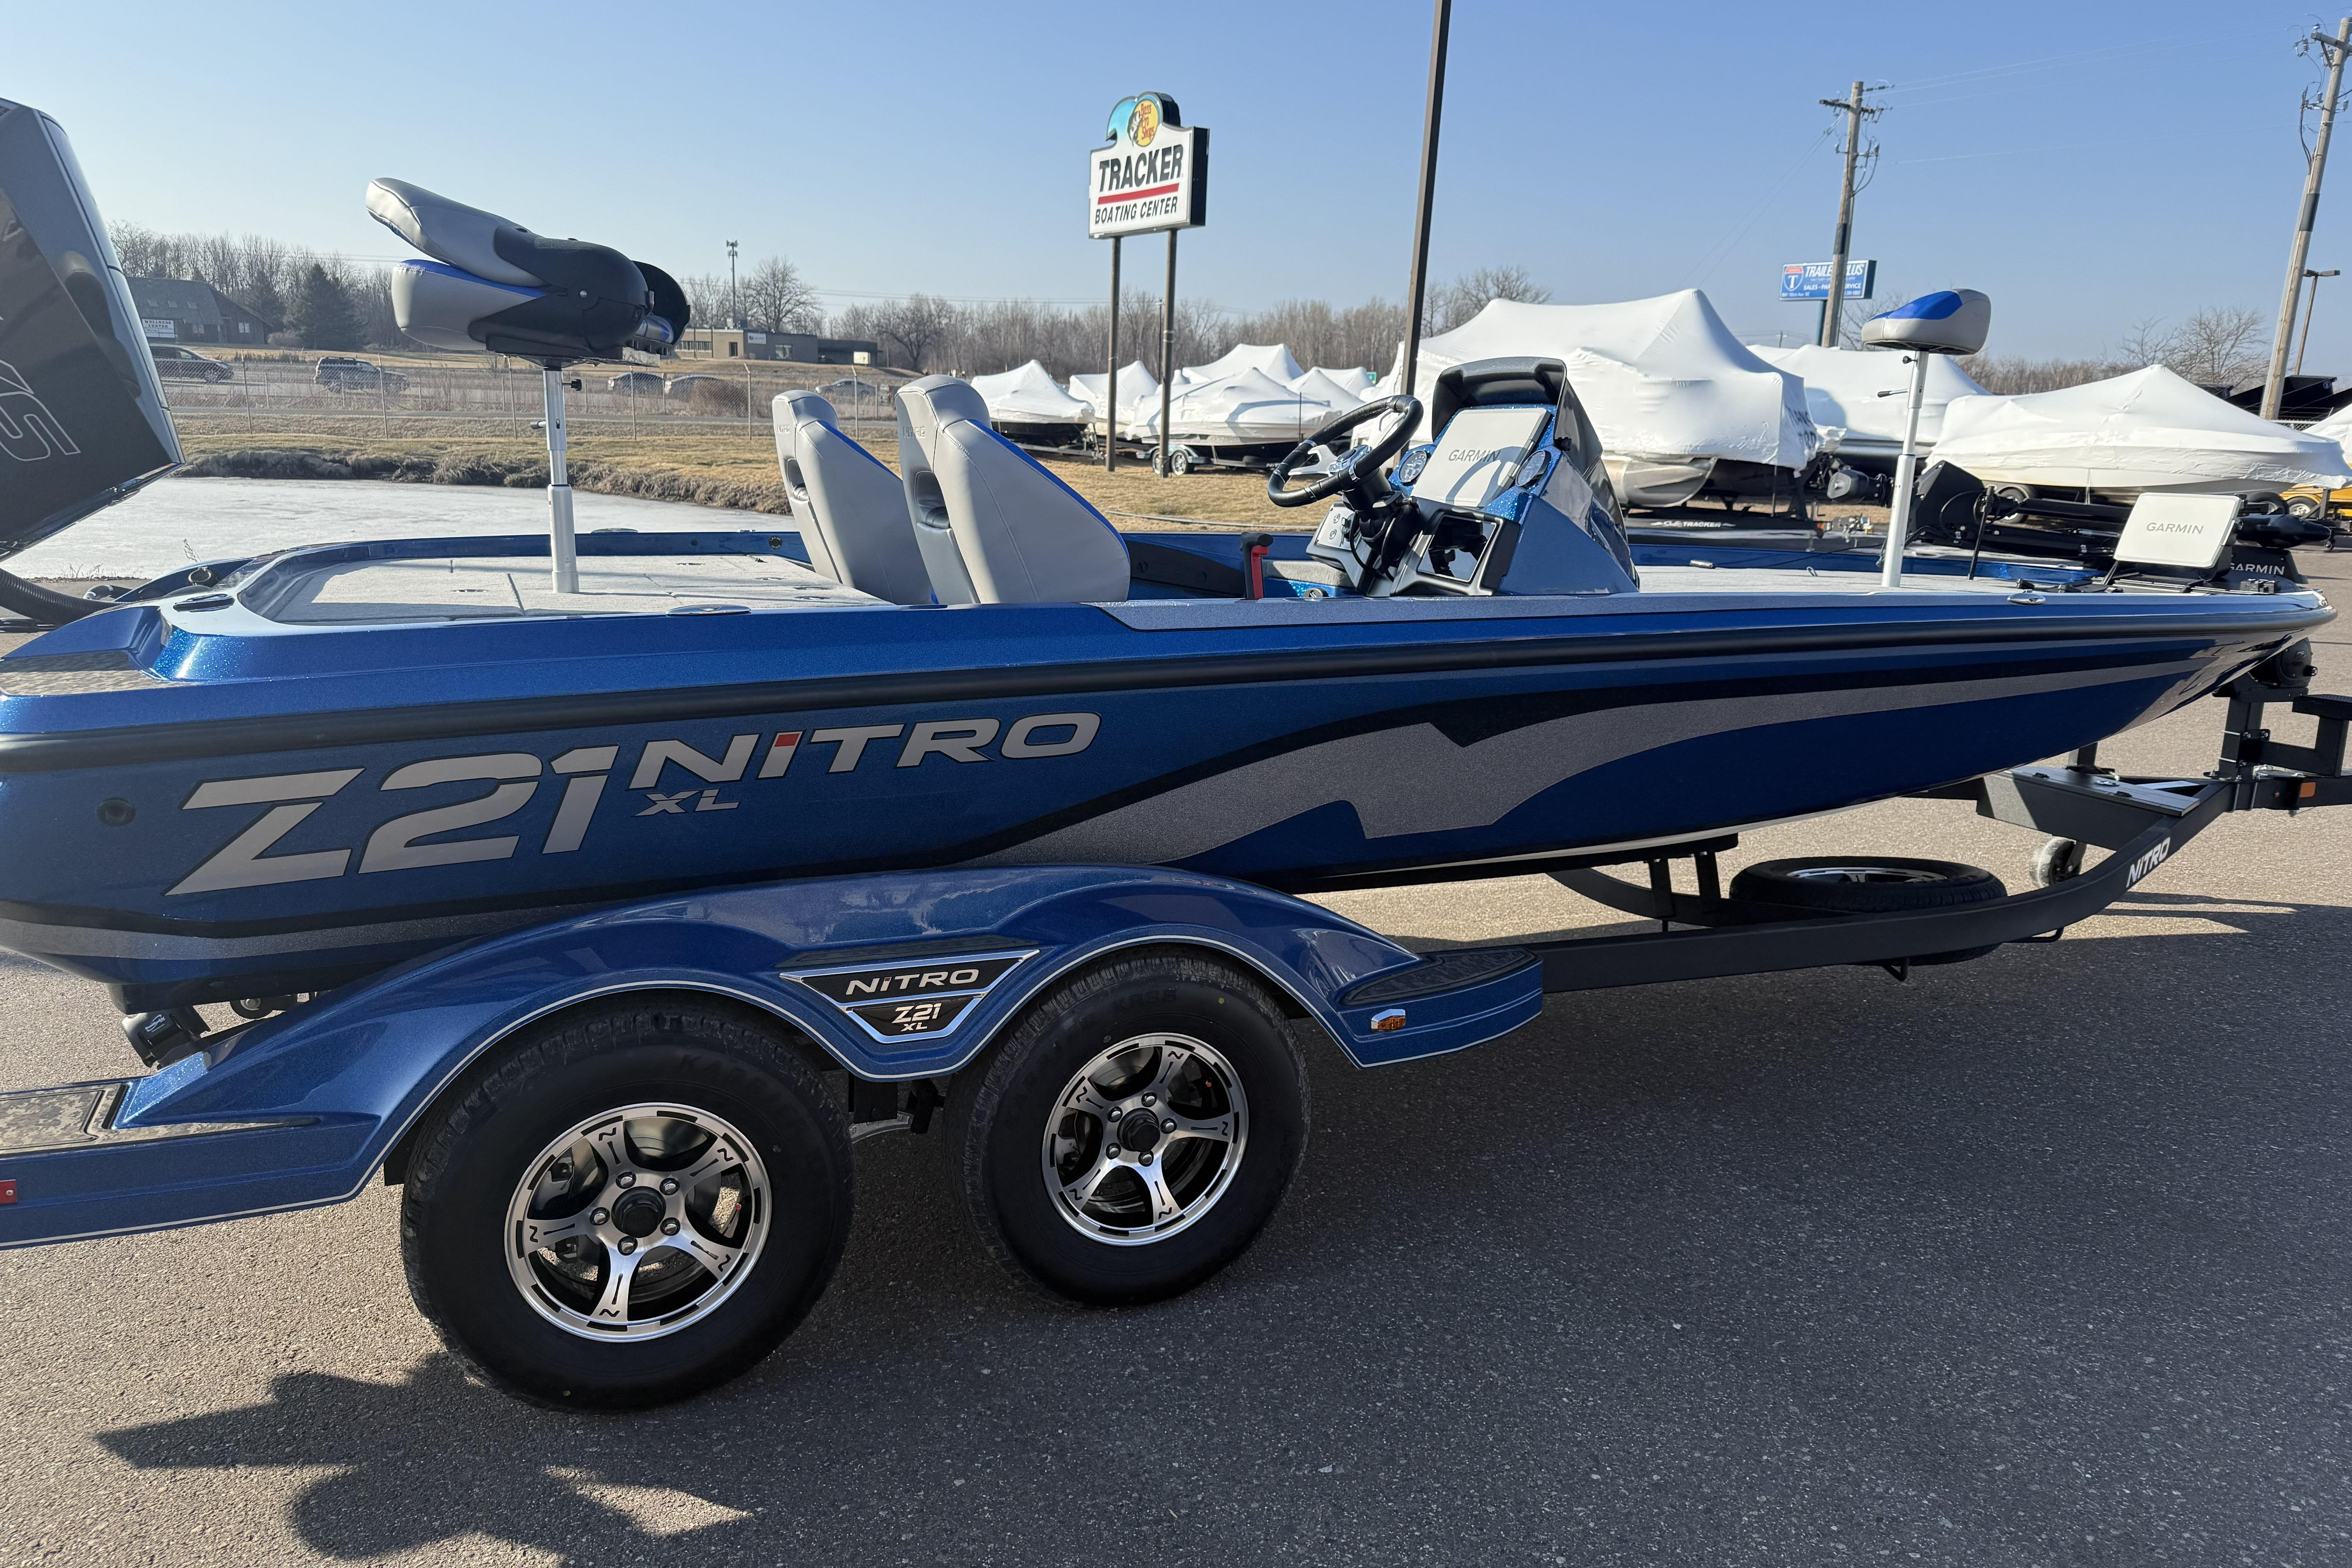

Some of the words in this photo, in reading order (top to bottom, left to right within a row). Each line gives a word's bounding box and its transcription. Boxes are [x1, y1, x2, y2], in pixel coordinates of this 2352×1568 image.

[1099, 144, 1184, 192] TRACKER
[1095, 205, 1137, 224] BOATING
[1140, 196, 1178, 218] CENTER
[1448, 449, 1501, 462] GARMIN
[2146, 522, 2204, 534] GARMIN
[165, 744, 620, 896] Z21
[628, 712, 1101, 790] NITRO
[633, 789, 740, 817] XL
[2126, 837, 2171, 888] NITRO
[845, 969, 979, 995] NITRO
[891, 1003, 942, 1025] Z21
[901, 1022, 928, 1032] XL
